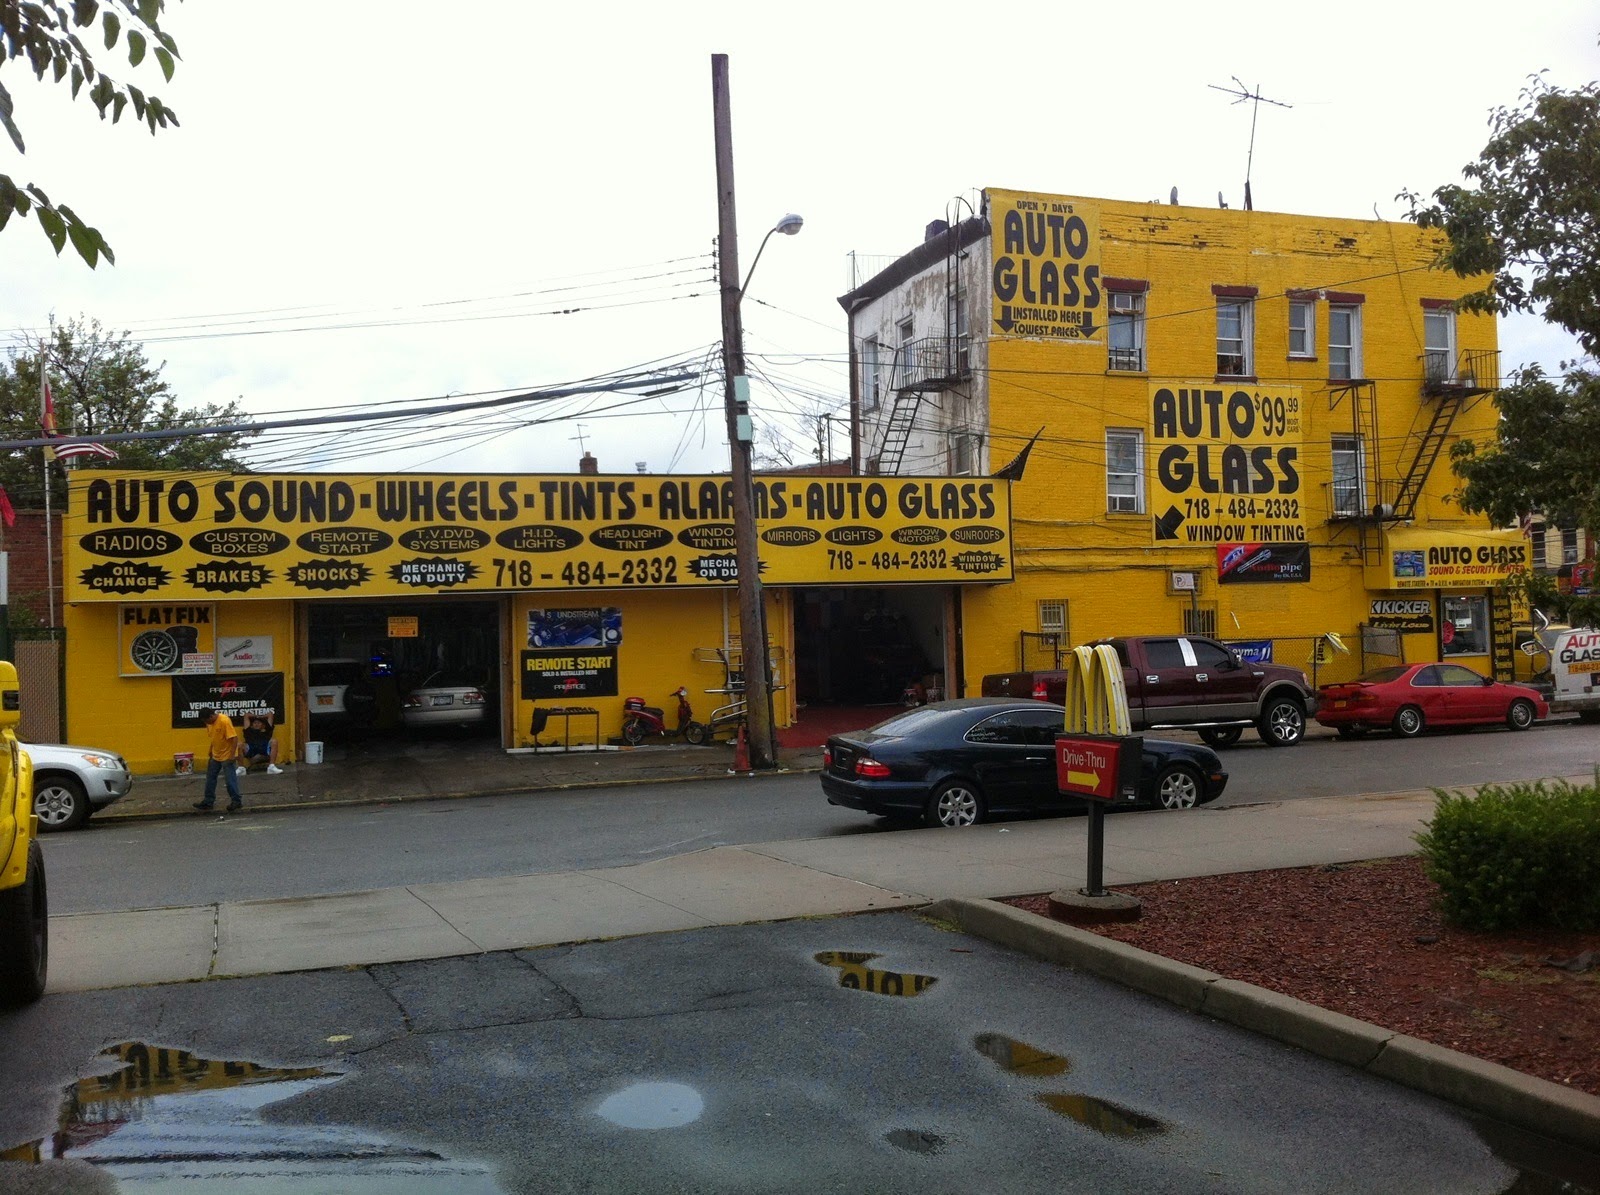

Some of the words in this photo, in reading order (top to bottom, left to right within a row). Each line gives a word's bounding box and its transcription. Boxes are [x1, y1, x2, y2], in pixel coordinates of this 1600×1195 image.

[1017, 200, 1038, 211] OPEN
[1042, 203, 1048, 211] 7
[1052, 203, 1073, 214] DAYS
[1004, 209, 1088, 260] AUTO
[993, 256, 1100, 308] GLASS
[1013, 306, 1058, 322] INSTALLED
[1060, 310, 1081, 324] HERE
[1014, 323, 1049, 336] LOWEST
[1051, 326, 1080, 338] PRICES
[1153, 388, 1255, 439] AUTO
[1157, 444, 1300, 494] GLASS
[87, 479, 199, 523] AUTO
[898, 482, 995, 520] GLASS
[204, 532, 276, 543] CUSTOM
[311, 532, 379, 542] REMOTE
[688, 527, 735, 538] WINDO
[767, 531, 816, 542] MIRRORS
[832, 530, 876, 541] LIGHTS
[898, 528, 940, 536] WINDOW
[954, 530, 1000, 540] SUNROOFS
[1186, 525, 1245, 542] WINDOW
[1251, 525, 1305, 541] TINTING
[95, 535, 167, 550] RADIOS
[410, 539, 480, 550] SYSTEMS
[514, 538, 566, 549] LIGHTS
[616, 539, 647, 549] TINT
[692, 538, 737, 547] TINTIN
[211, 543, 269, 554] BOXES
[319, 543, 371, 554] START
[1428, 546, 1472, 564] AUTO
[1477, 546, 1526, 564] GLASS
[402, 562, 465, 574] MECHANIC
[700, 559, 737, 568] MECHA
[960, 562, 997, 570] TINTING
[112, 566, 138, 576] OIL
[298, 567, 360, 581] SHOCKS
[700, 568, 717, 577] ON
[721, 568, 738, 577] DU
[1429, 565, 1454, 575] SOUND
[1461, 565, 1497, 575] SECURITY
[93, 576, 157, 587] CHANGE
[196, 569, 261, 583] BRAKES
[401, 573, 423, 583] ON
[427, 573, 466, 583] DUTY
[1381, 600, 1431, 614] KICKER
[1565, 634, 1600, 649] AUT
[1560, 649, 1600, 664] GLAS
[526, 658, 575, 671] REMOTE
[577, 656, 613, 669] START
[189, 701, 221, 710] VEHICLE
[222, 700, 259, 709] SECURITY
[260, 699, 267, 708] &
[214, 708, 238, 717] START
[240, 707, 275, 717] SYSTEMS
[1062, 748, 1106, 769] Drive-Thru
